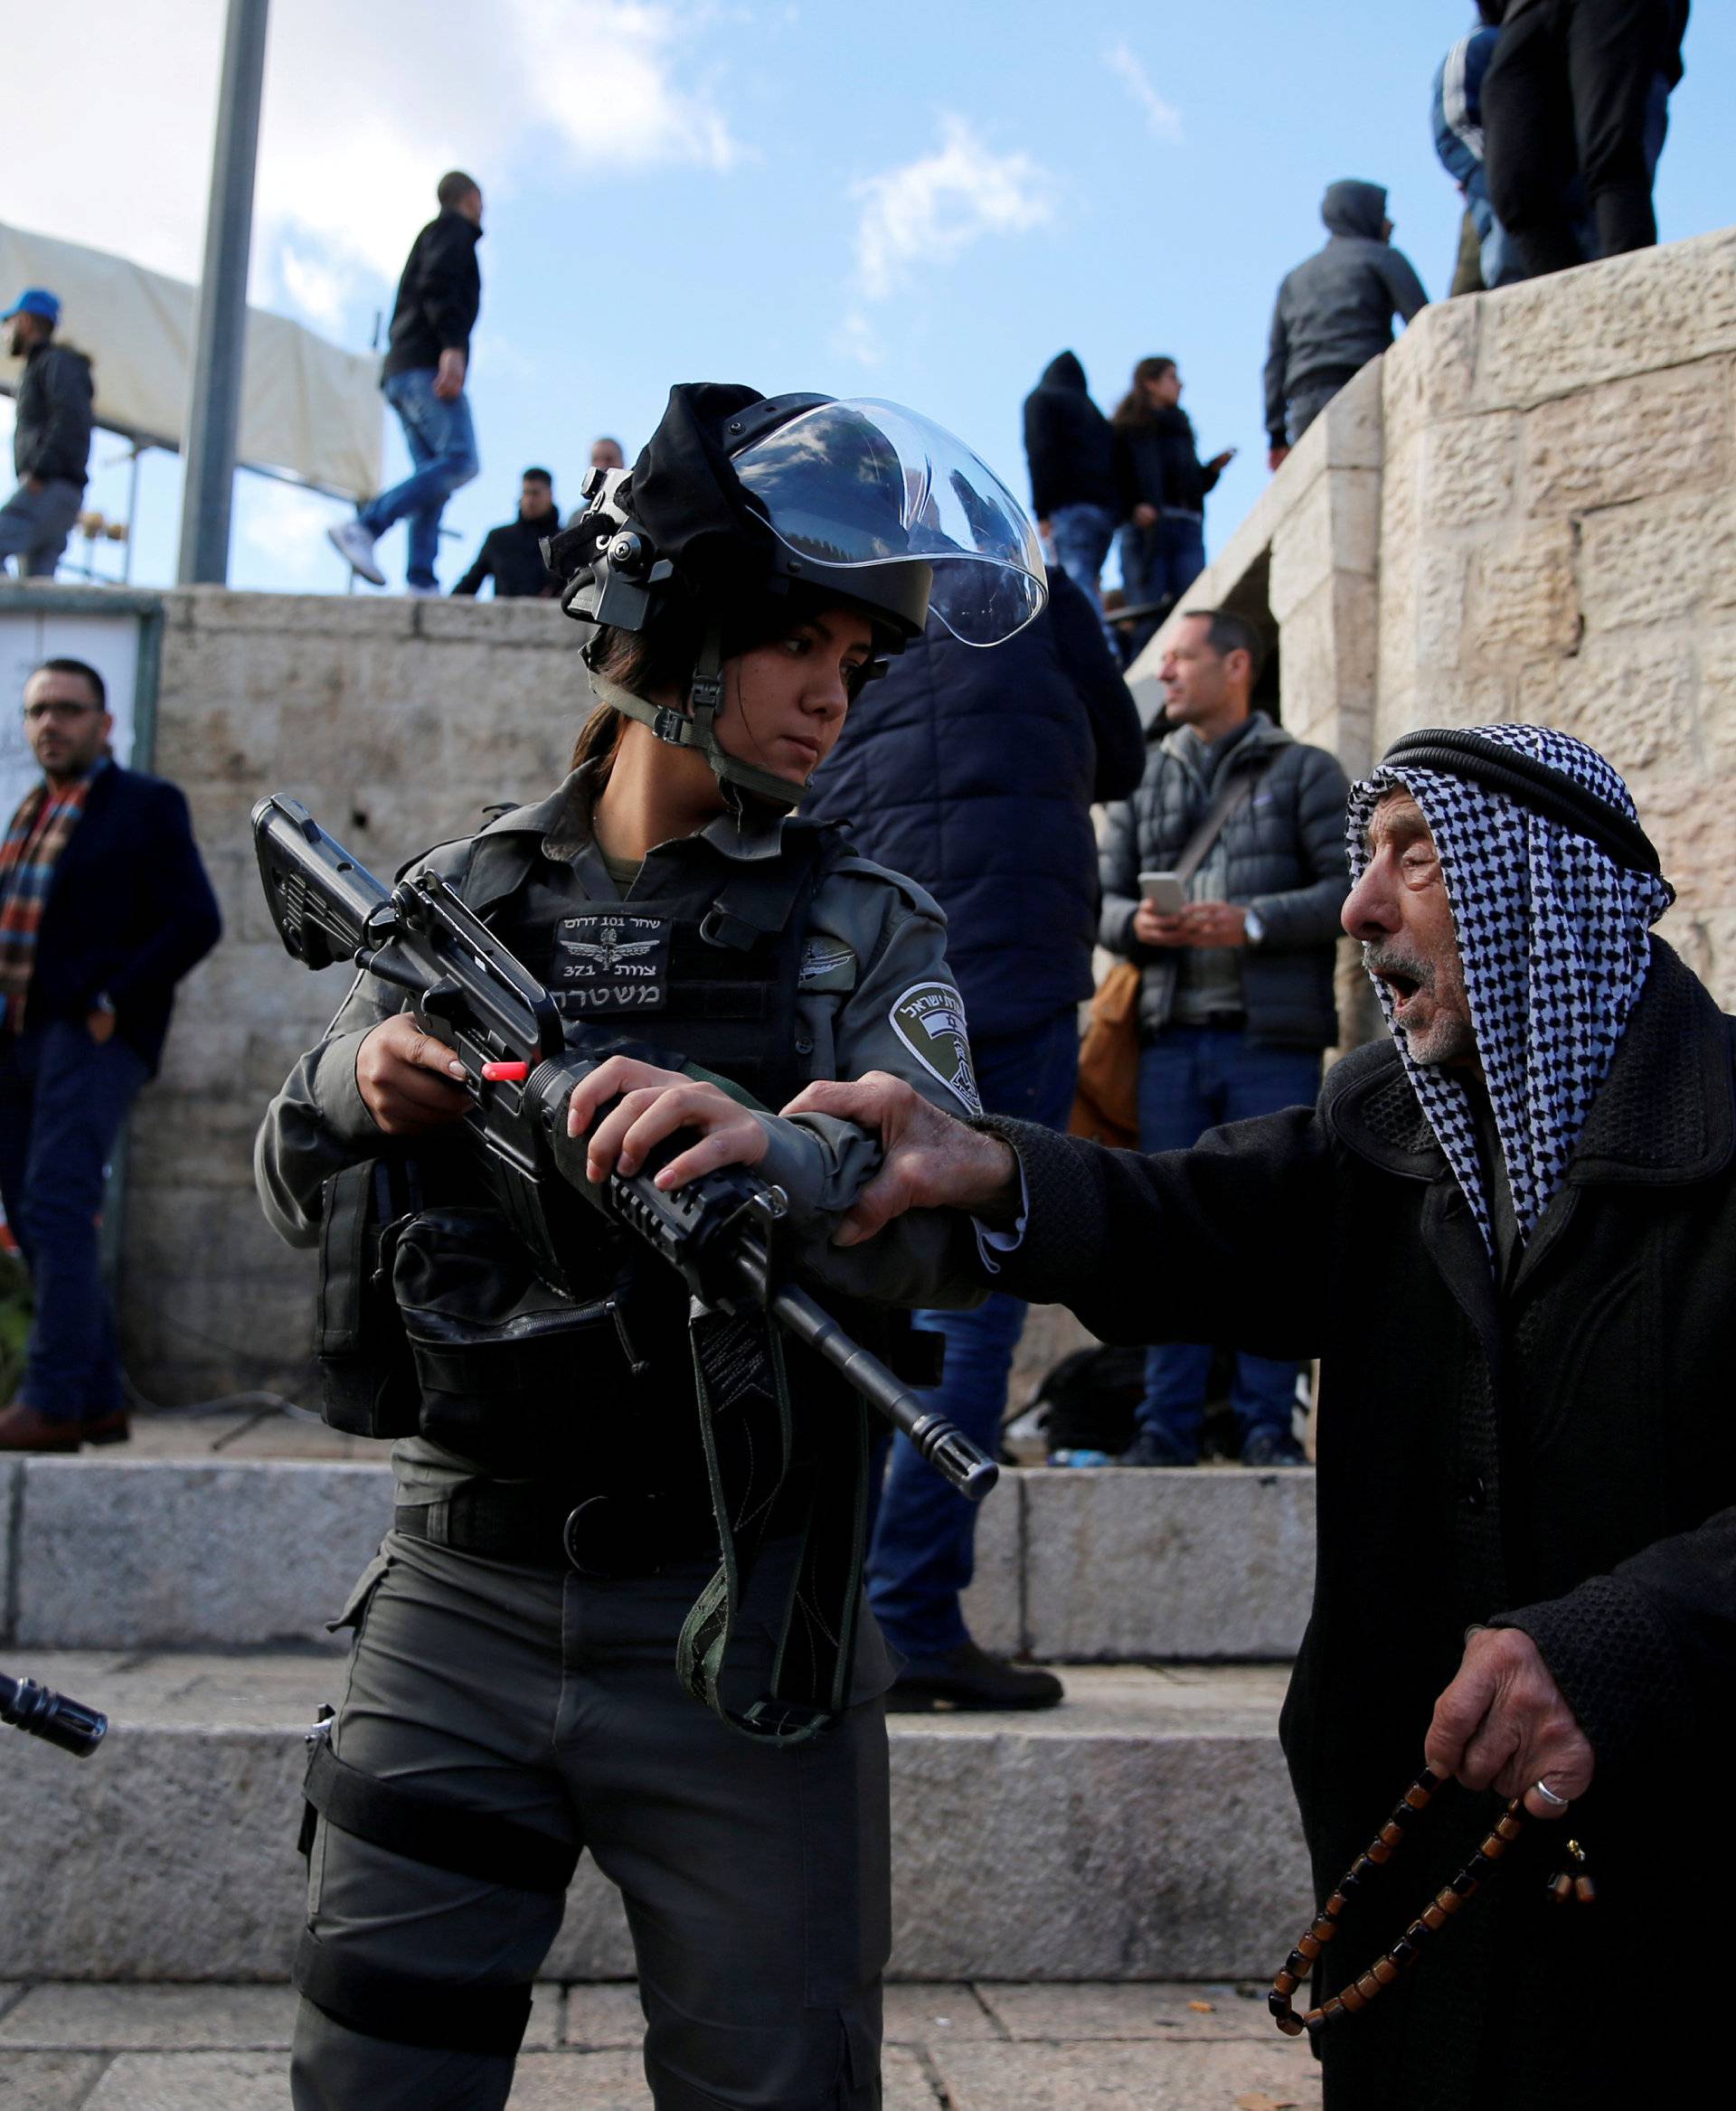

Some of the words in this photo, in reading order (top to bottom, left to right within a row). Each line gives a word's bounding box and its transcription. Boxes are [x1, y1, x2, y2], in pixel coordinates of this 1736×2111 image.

[563, 916, 598, 928] דרום
[599, 916, 626, 927] 101
[629, 917, 661, 929] שחר
[614, 964, 656, 976] צוות
[899, 994, 943, 1018] ישראל
